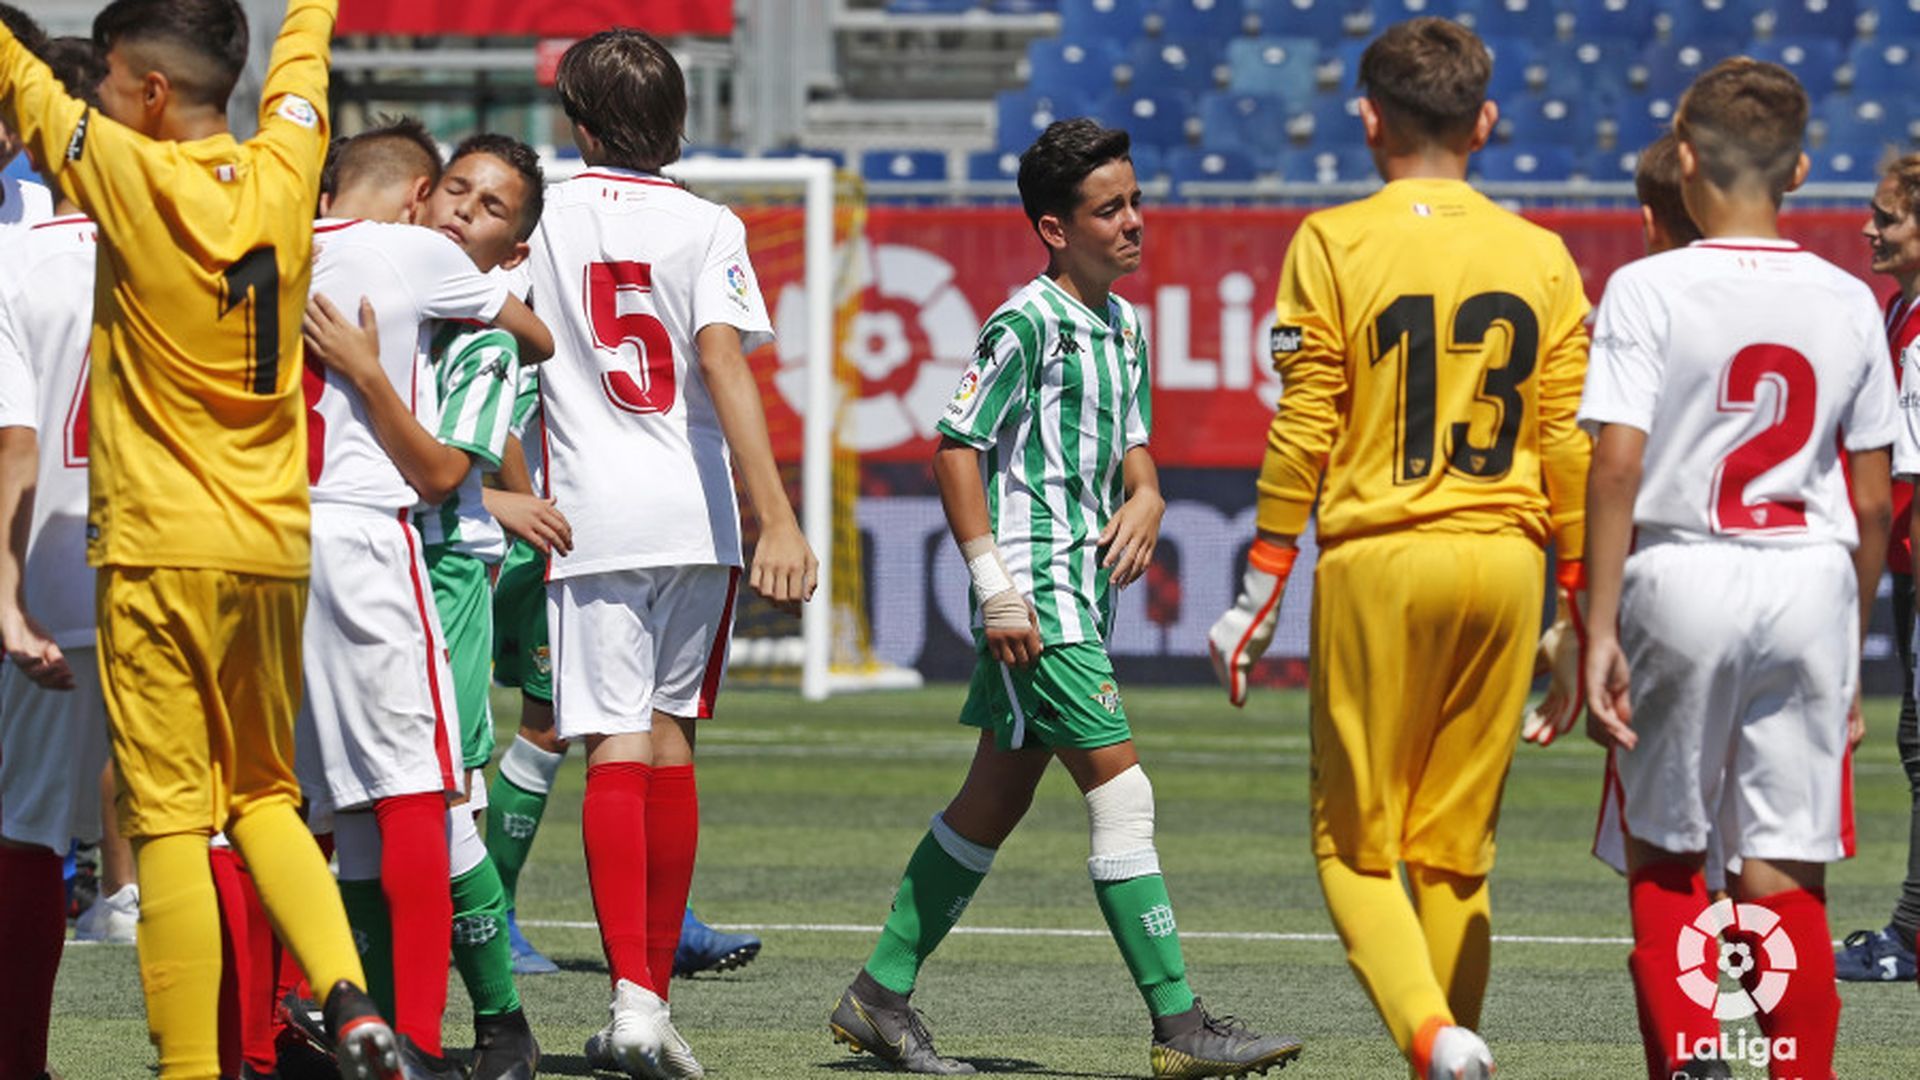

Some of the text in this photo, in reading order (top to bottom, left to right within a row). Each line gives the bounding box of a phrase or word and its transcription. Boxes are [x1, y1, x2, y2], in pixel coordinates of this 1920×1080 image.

[217, 246, 280, 394] 1
[583, 261, 676, 416] 5
[1367, 291, 1540, 487] 13
[1709, 343, 1818, 536] 2
